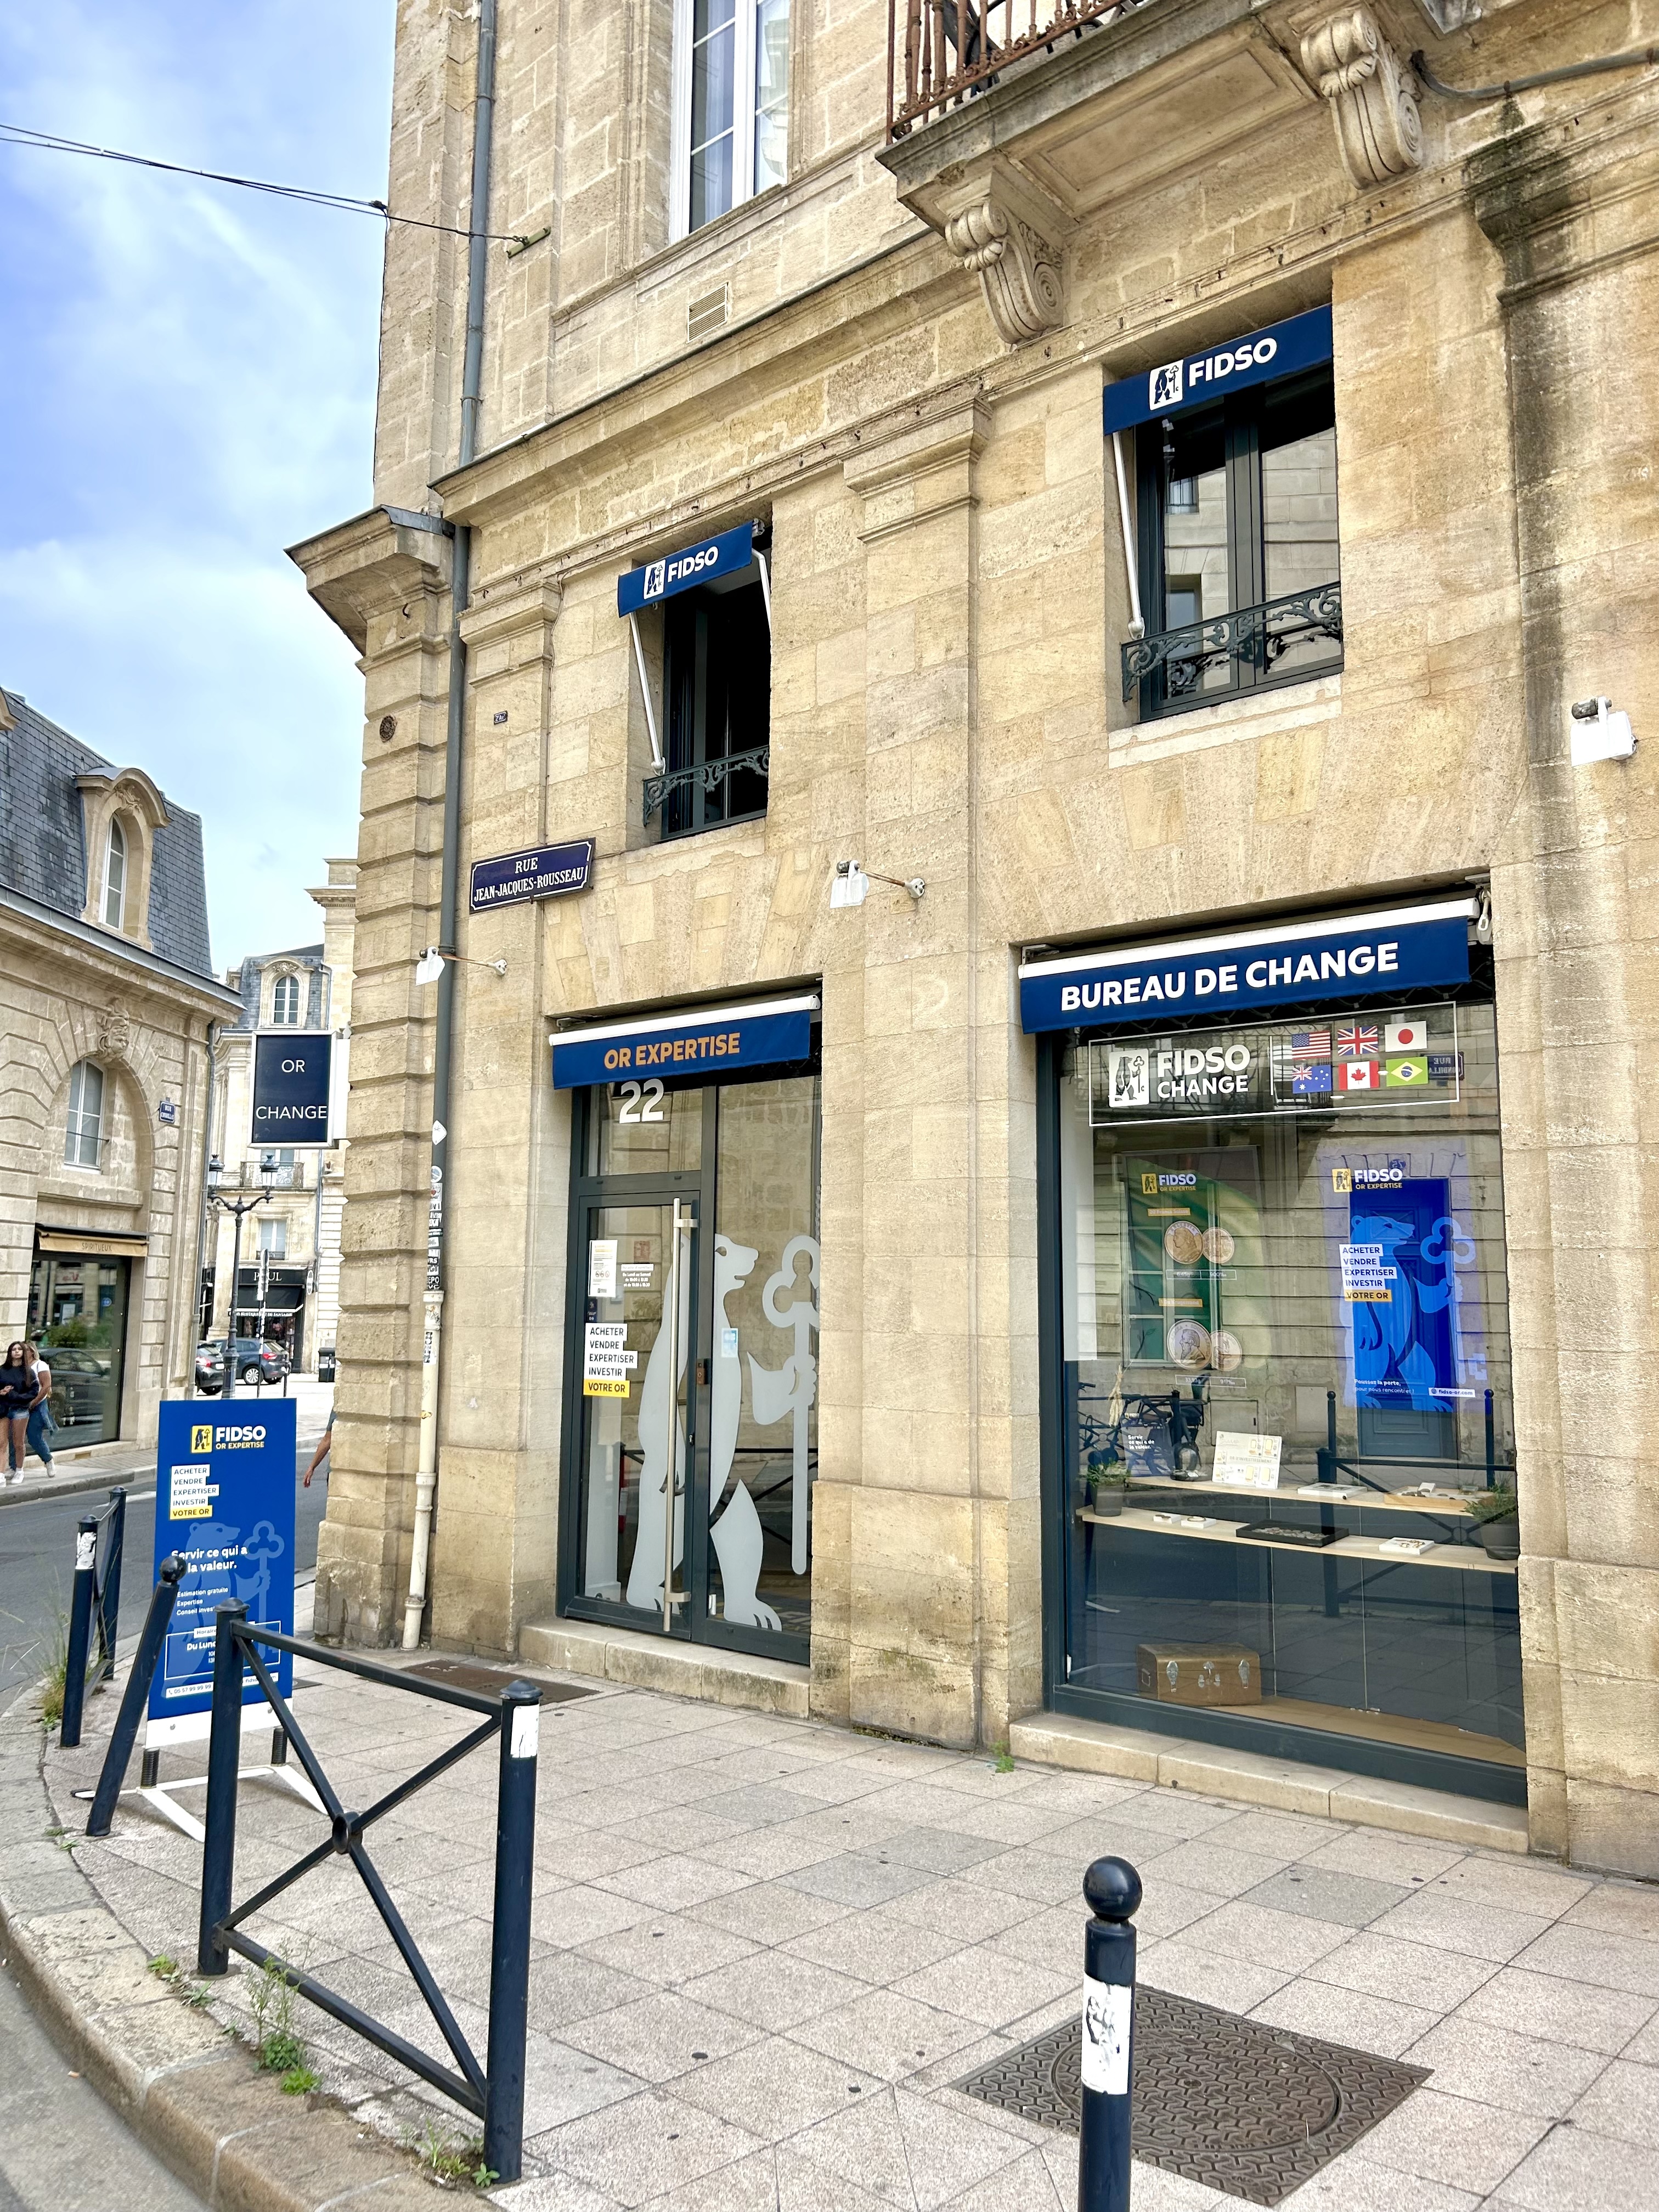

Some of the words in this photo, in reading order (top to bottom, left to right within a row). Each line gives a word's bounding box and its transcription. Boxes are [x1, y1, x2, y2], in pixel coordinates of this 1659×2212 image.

[1189, 337, 1277, 387] FIDSO
[667, 546, 719, 583] FIDSO
[515, 857, 538, 874] RUE
[474, 866, 584, 902] JEAN-JACQUES-ROUSSEAU
[1060, 971, 1186, 1011] BUREAU
[1194, 964, 1238, 996] DE
[1245, 942, 1399, 986] CHANGE
[604, 1047, 631, 1069] OR
[635, 1032, 740, 1066] EXPERTISE
[281, 1059, 306, 1073] OR
[1157, 1044, 1251, 1078] FIDSO
[1157, 1074, 1249, 1098] CHANGE
[619, 1078, 664, 1124] 22
[256, 1105, 328, 1120] CHANGE
[1158, 1173, 1197, 1186] FIDSO
[1354, 1168, 1403, 1183] FIDSO
[82, 1242, 112, 1251] SPIRITUEUX
[253, 1271, 283, 1282] PUL
[590, 1327, 624, 1336] ACHETER
[590, 1340, 620, 1349] VENDRE
[589, 1353, 634, 1363] EXPERTISER
[589, 1367, 623, 1376] INVESTIR
[588, 1383, 613, 1392] VOTRE
[614, 1384, 626, 1393] OR
[216, 1425, 266, 1442] FIDSO
[228, 1441, 265, 1449] EXPERTISE
[173, 1487, 217, 1496] EXPERTISER
[173, 1498, 206, 1506] INVESTIR
[173, 1509, 198, 1517] VOTRE
[171, 1548, 205, 1560] Servir
[221, 1545, 239, 1559] qui
[240, 1546, 248, 1555] a
[188, 1562, 198, 1573] la
[200, 1560, 237, 1572] valeur.
[177, 1589, 206, 1598] Estimation
[207, 1587, 228, 1596] gratuite
[177, 1599, 204, 1607] Expertise
[176, 1607, 198, 1616] Conseil
[198, 1606, 215, 1614] inves
[187, 1643, 198, 1651] Du
